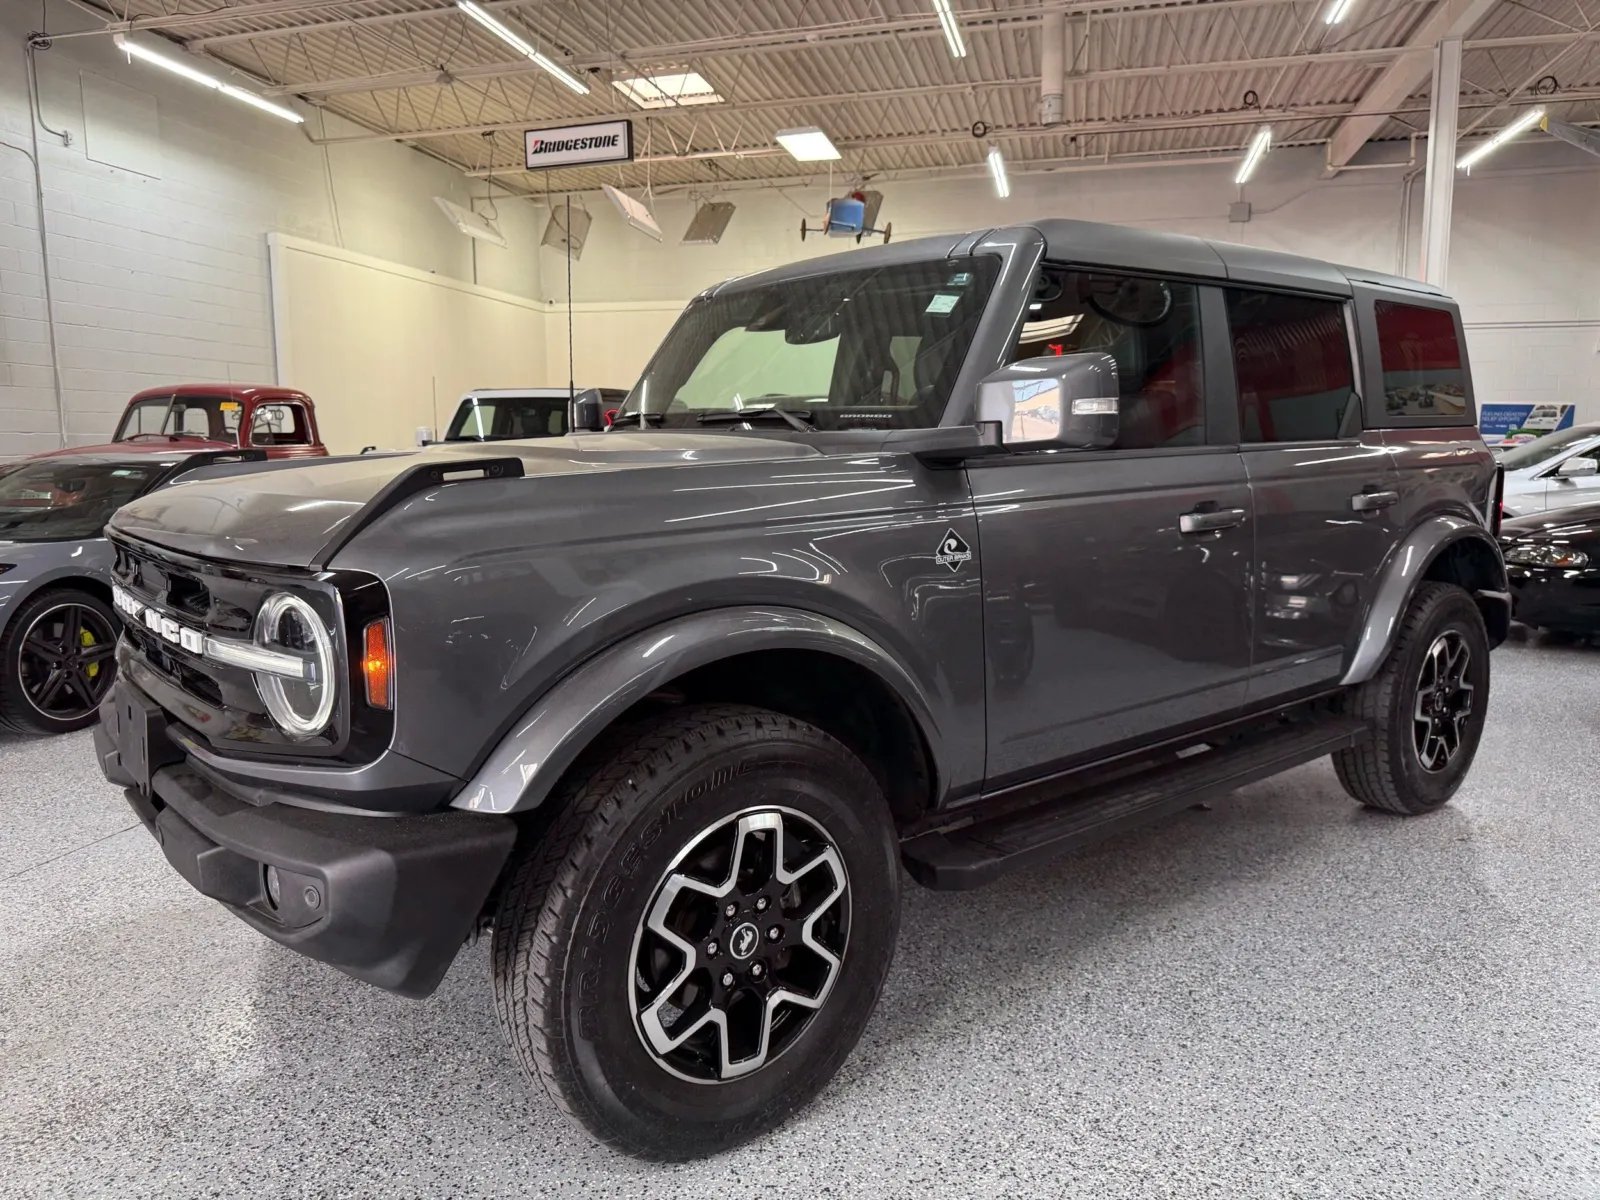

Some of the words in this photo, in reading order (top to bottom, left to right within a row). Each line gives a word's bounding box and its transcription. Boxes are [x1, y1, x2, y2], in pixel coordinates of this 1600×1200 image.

[531, 135, 619, 154] BRIDGESTONE
[937, 555, 953, 563] OUTER
[954, 552, 971, 560] BANKS
[577, 761, 757, 1040] BRIDGESTONE
